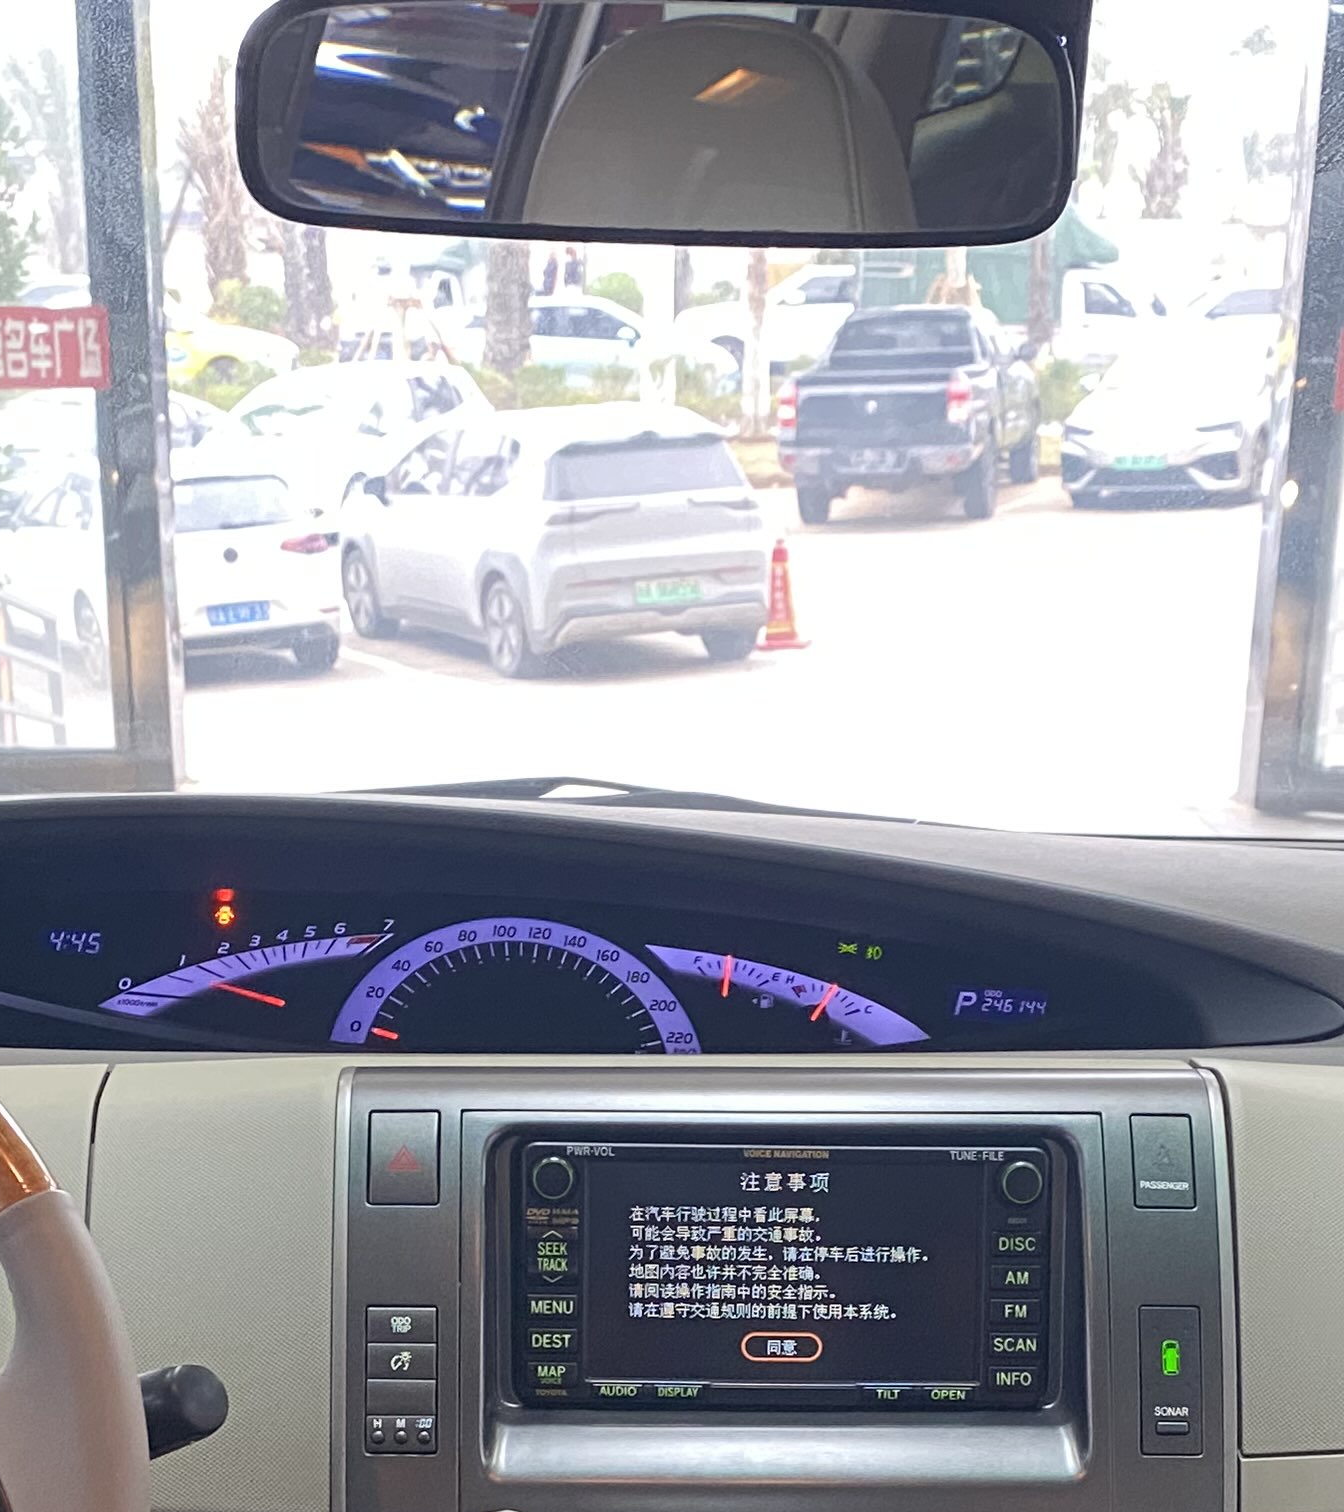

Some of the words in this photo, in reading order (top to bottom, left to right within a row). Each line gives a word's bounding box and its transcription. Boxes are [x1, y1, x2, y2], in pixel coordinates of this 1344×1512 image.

[50, 931, 102, 954] 4:45
[118, 977, 132, 990] 0
[217, 942, 231, 955] 2
[249, 935, 261, 947] 3
[275, 929, 289, 942] 4
[303, 925, 316, 938] 5
[333, 922, 347, 934] 6
[383, 919, 395, 931] 7
[350, 1020, 362, 1032] 0
[366, 986, 385, 999] 20
[392, 960, 412, 972] 40
[424, 941, 444, 953] 60
[458, 930, 477, 943] 80
[492, 925, 517, 938] 100
[528, 927, 552, 939] 120
[563, 935, 587, 948] 140
[596, 949, 620, 962] 160
[626, 971, 650, 984] 180
[649, 1000, 677, 1012] 200
[666, 1032, 693, 1044] 220
[772, 972, 782, 982] E
[785, 975, 795, 984] H
[954, 991, 977, 1015] P
[981, 998, 1047, 1014] 246144
[743, 1149, 770, 1159] VOICE
[773, 1149, 829, 1159] NAVIGATION
[740, 1172, 830, 1194] 注意事项
[1139, 1181, 1189, 1191] PASSENGER
[629, 1225, 822, 1243] 可能会导致严重的交通事故。
[537, 1242, 567, 1256] SEEK
[998, 1236, 1037, 1252] DISC
[537, 1257, 568, 1272] TRACK
[628, 1264, 822, 1281] 地图内容也许并不完全准确。
[1005, 1271, 1029, 1285] AM
[530, 1299, 574, 1315] MENU
[1004, 1304, 1027, 1319] FM
[390, 1316, 411, 1324] ODO
[391, 1324, 411, 1333] TRIP
[531, 1333, 571, 1349] DEST
[767, 1339, 798, 1356] 同意
[994, 1338, 1037, 1353] SCAN
[537, 1365, 566, 1377] MAP
[996, 1371, 1032, 1387] INFO
[599, 1386, 638, 1397] AUDIO
[657, 1387, 699, 1398] DISPLAY
[874, 1389, 900, 1400] TILT
[931, 1389, 966, 1401] OPEN
[1154, 1406, 1189, 1417] SONAR
